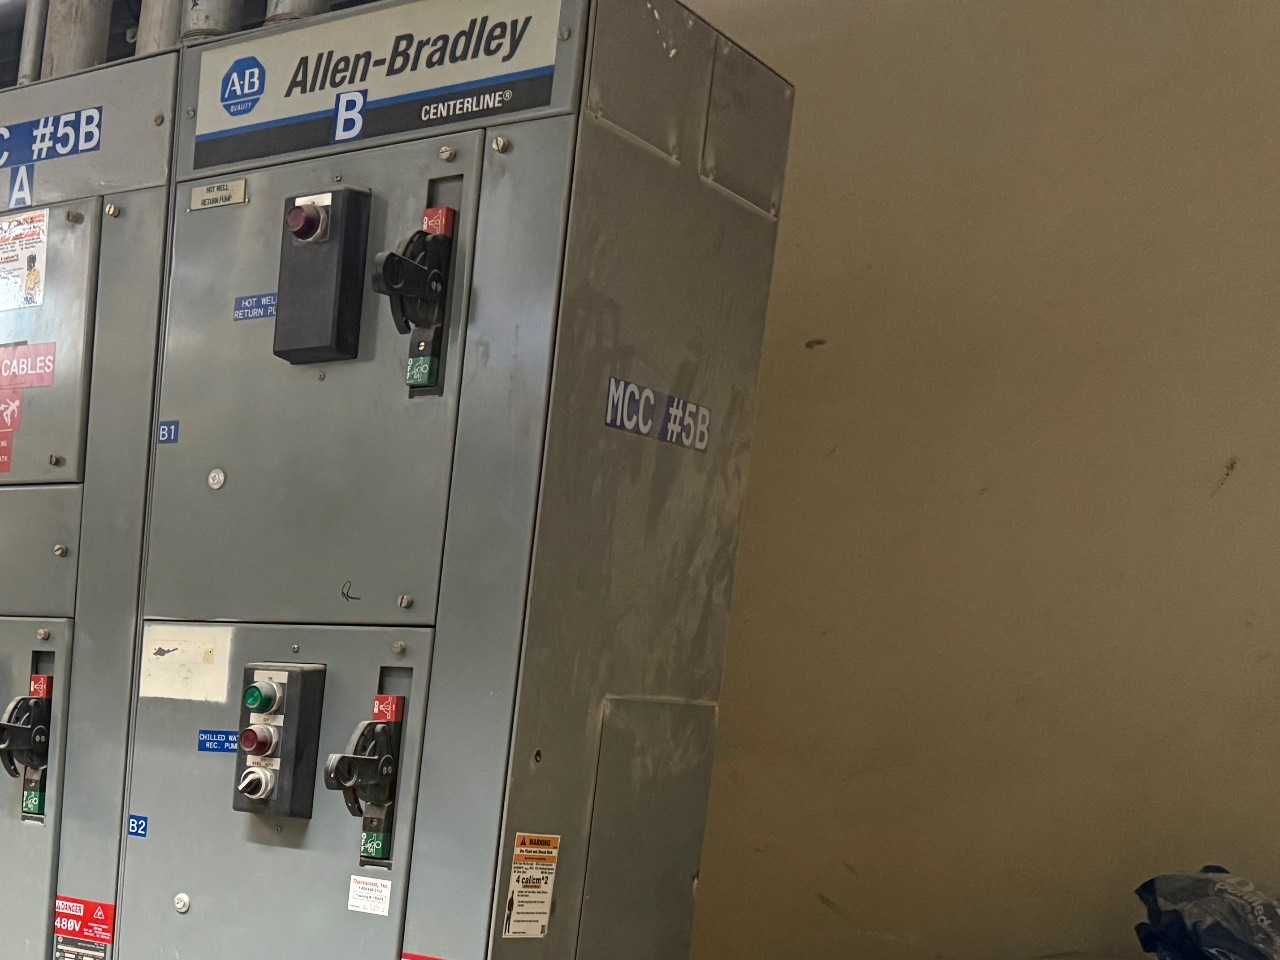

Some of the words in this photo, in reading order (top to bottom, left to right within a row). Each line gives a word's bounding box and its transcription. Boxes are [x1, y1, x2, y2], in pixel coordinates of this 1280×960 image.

[284, 15, 532, 98] Allen-Bradley
[335, 92, 365, 141] B
[31, 108, 100, 160] #5B
[9, 166, 32, 208] A
[242, 298, 257, 306] HOT
[234, 308, 263, 319] RETURN
[268, 307, 276, 317] PU
[1, 356, 54, 376] CABLES
[606, 378, 655, 434] MCC
[666, 397, 710, 450] #5B
[159, 425, 176, 440] B1
[129, 820, 146, 834] B2
[516, 875, 521, 885] 4
